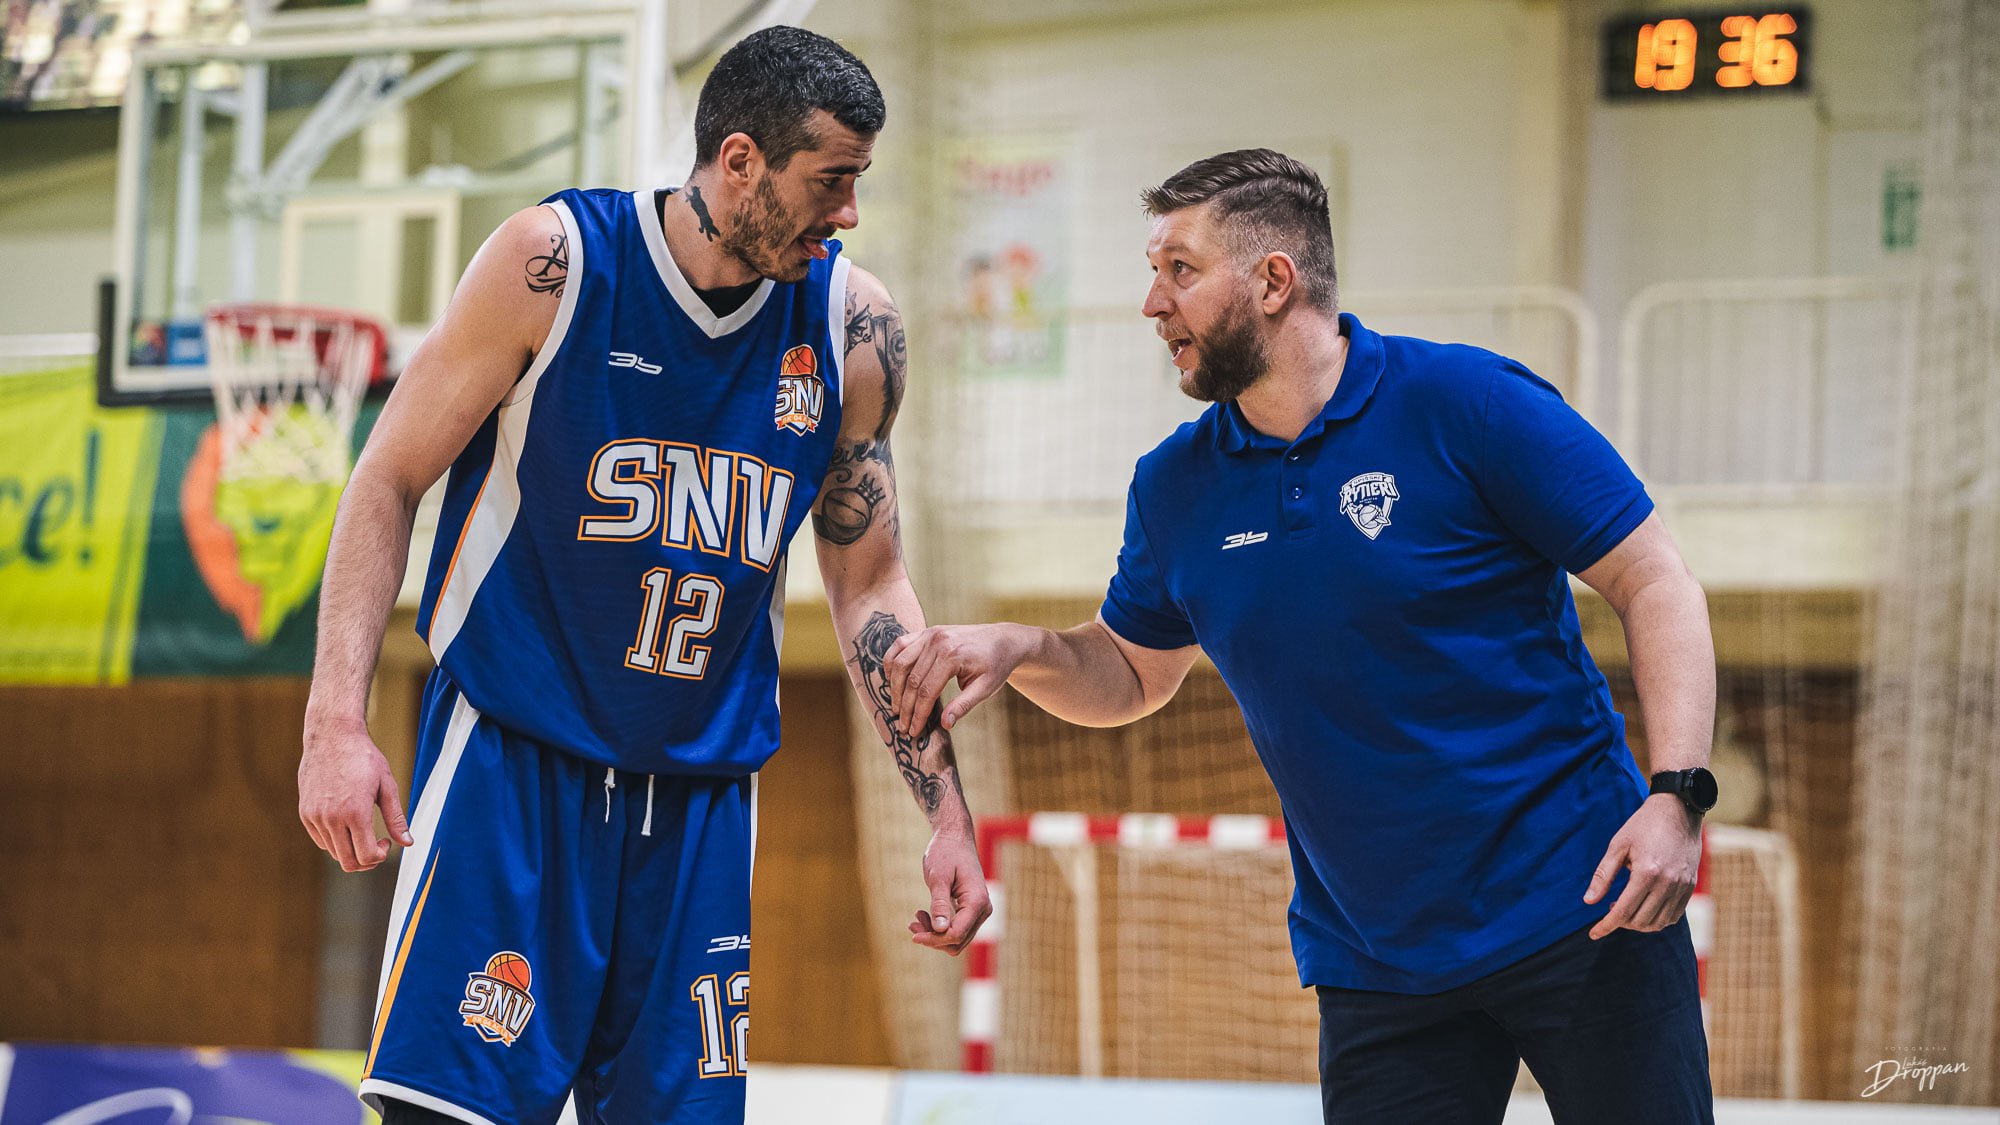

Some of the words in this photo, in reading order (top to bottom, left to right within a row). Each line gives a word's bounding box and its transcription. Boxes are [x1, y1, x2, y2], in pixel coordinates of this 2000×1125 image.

[1635, 18, 1697, 91] 19
[1715, 13, 1798, 88] 36
[774, 378, 823, 420] SNV
[577, 437, 795, 573] SNV
[624, 567, 725, 681] 12
[460, 977, 532, 1036] SNV
